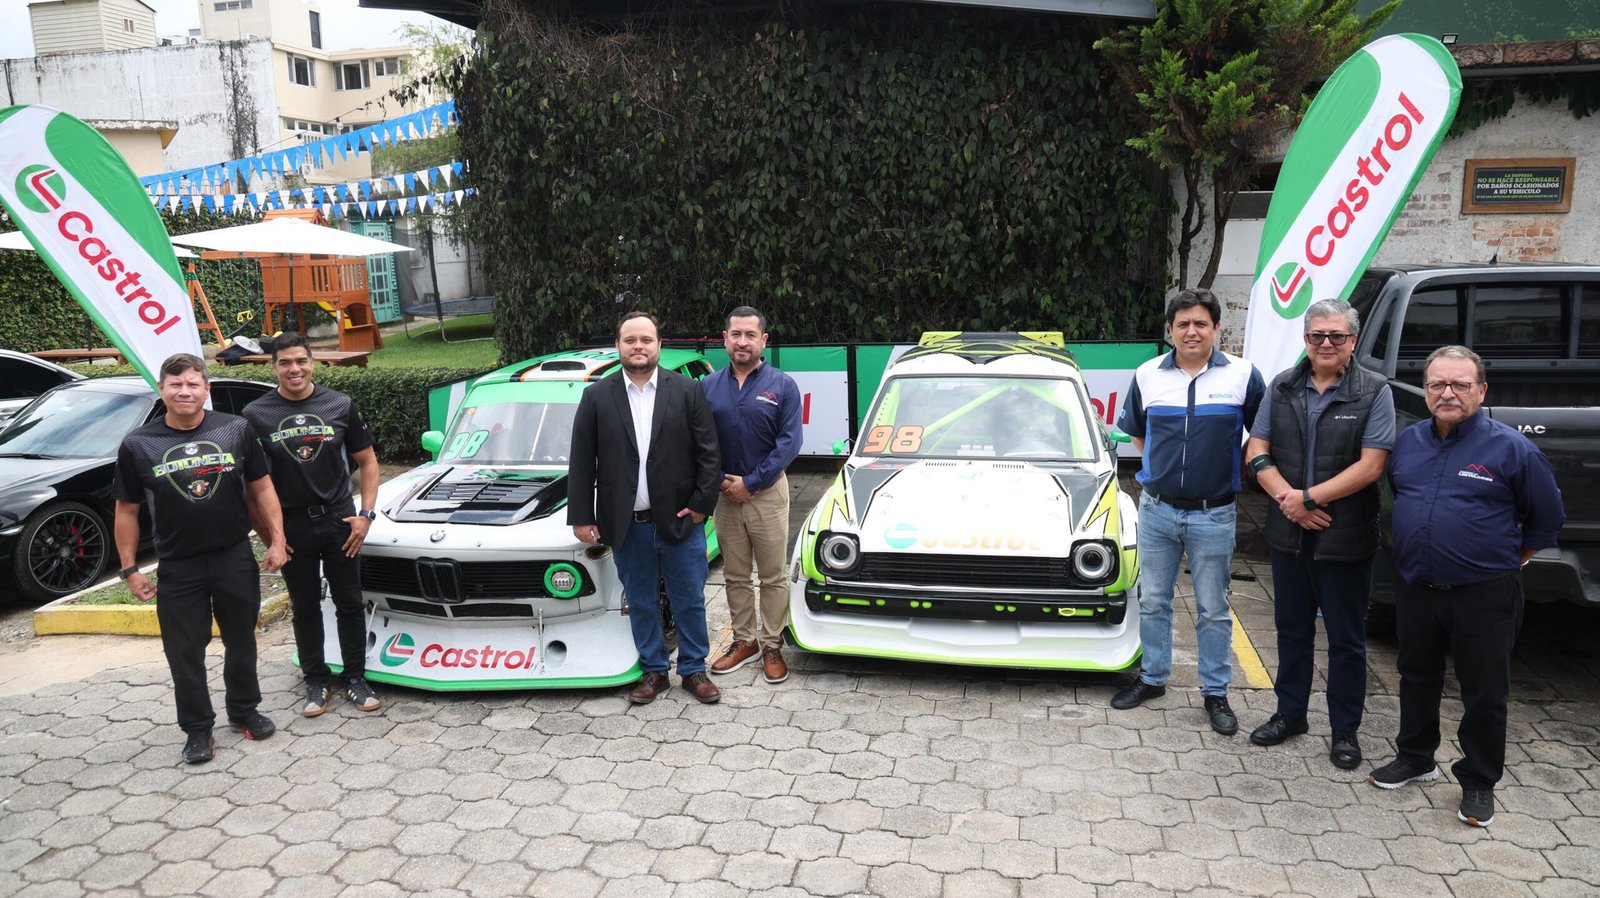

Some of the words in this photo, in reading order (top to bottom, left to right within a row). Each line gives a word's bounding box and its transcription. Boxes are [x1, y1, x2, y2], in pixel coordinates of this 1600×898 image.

[1306, 91, 1424, 267] Castrol
[58, 211, 182, 336] Castrol
[443, 430, 490, 459] 98
[862, 425, 924, 453] 98
[152, 453, 235, 478] BOTONETA
[420, 643, 536, 669] Castrol
